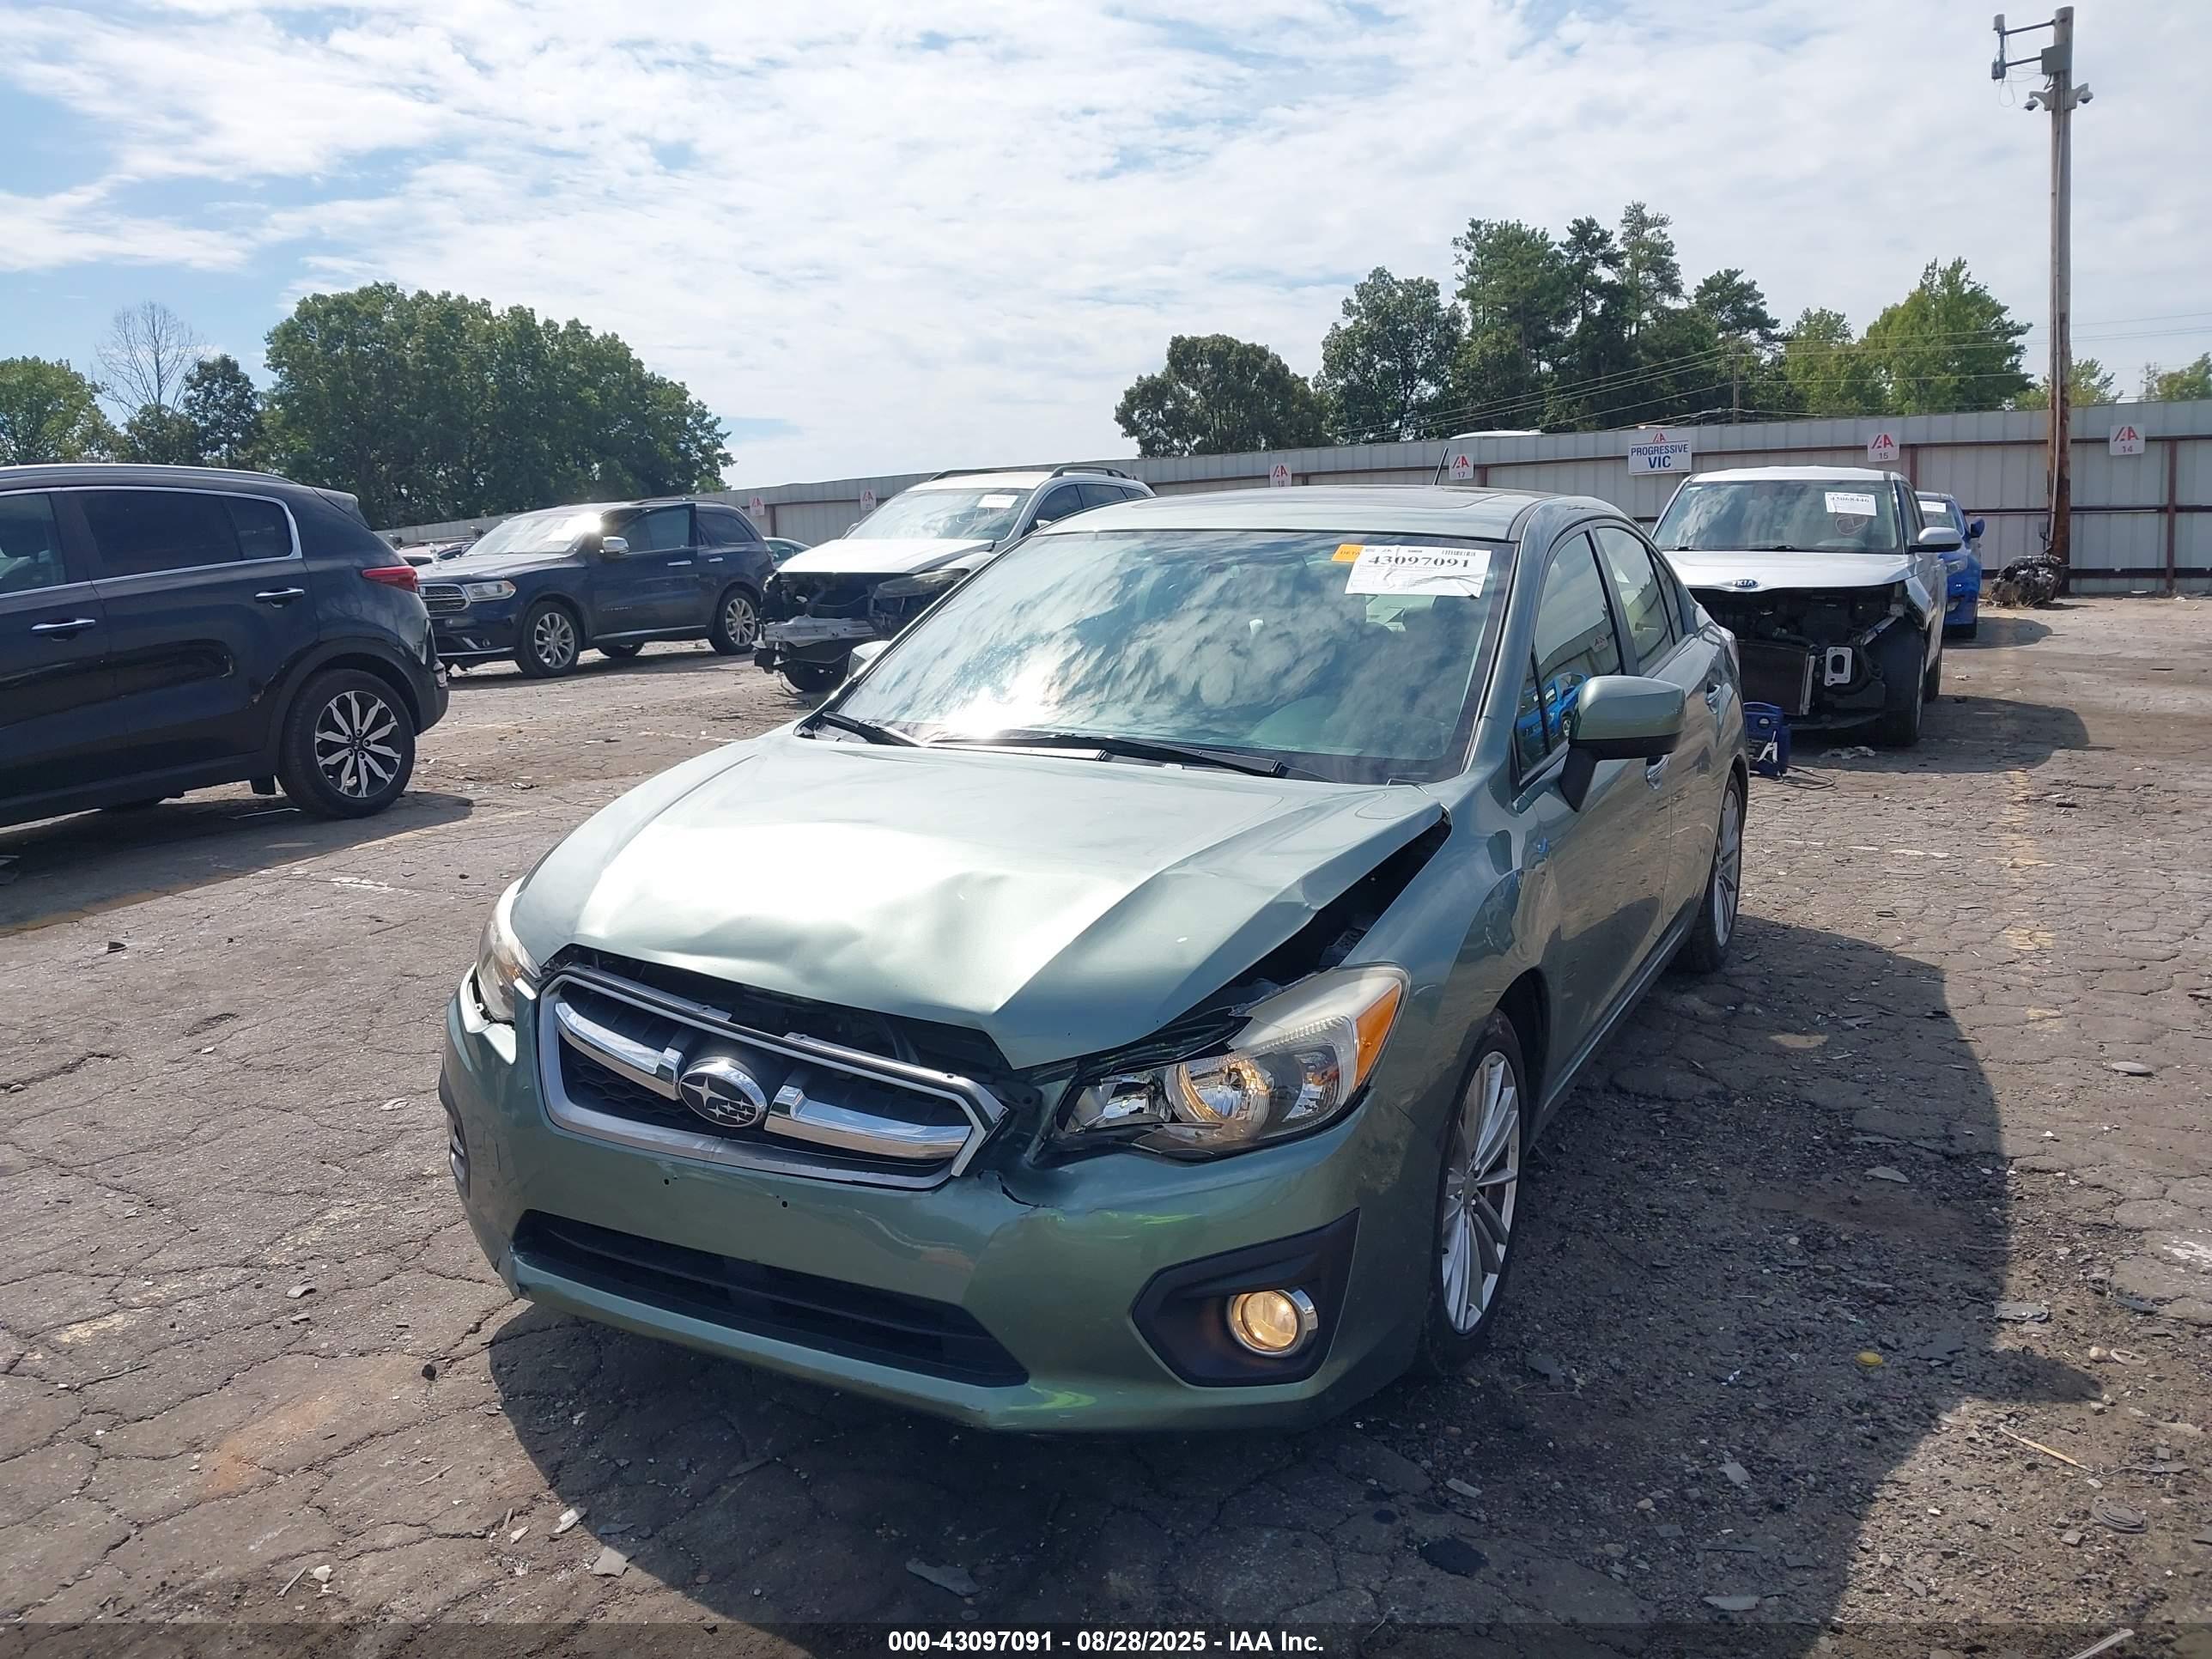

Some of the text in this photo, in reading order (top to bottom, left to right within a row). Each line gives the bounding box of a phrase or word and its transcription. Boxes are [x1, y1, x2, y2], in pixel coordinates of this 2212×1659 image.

[1631, 443, 1689, 457] PROGRESSIVE
[1648, 455, 1671, 469] VIC
[1367, 555, 1470, 568] 43097091
